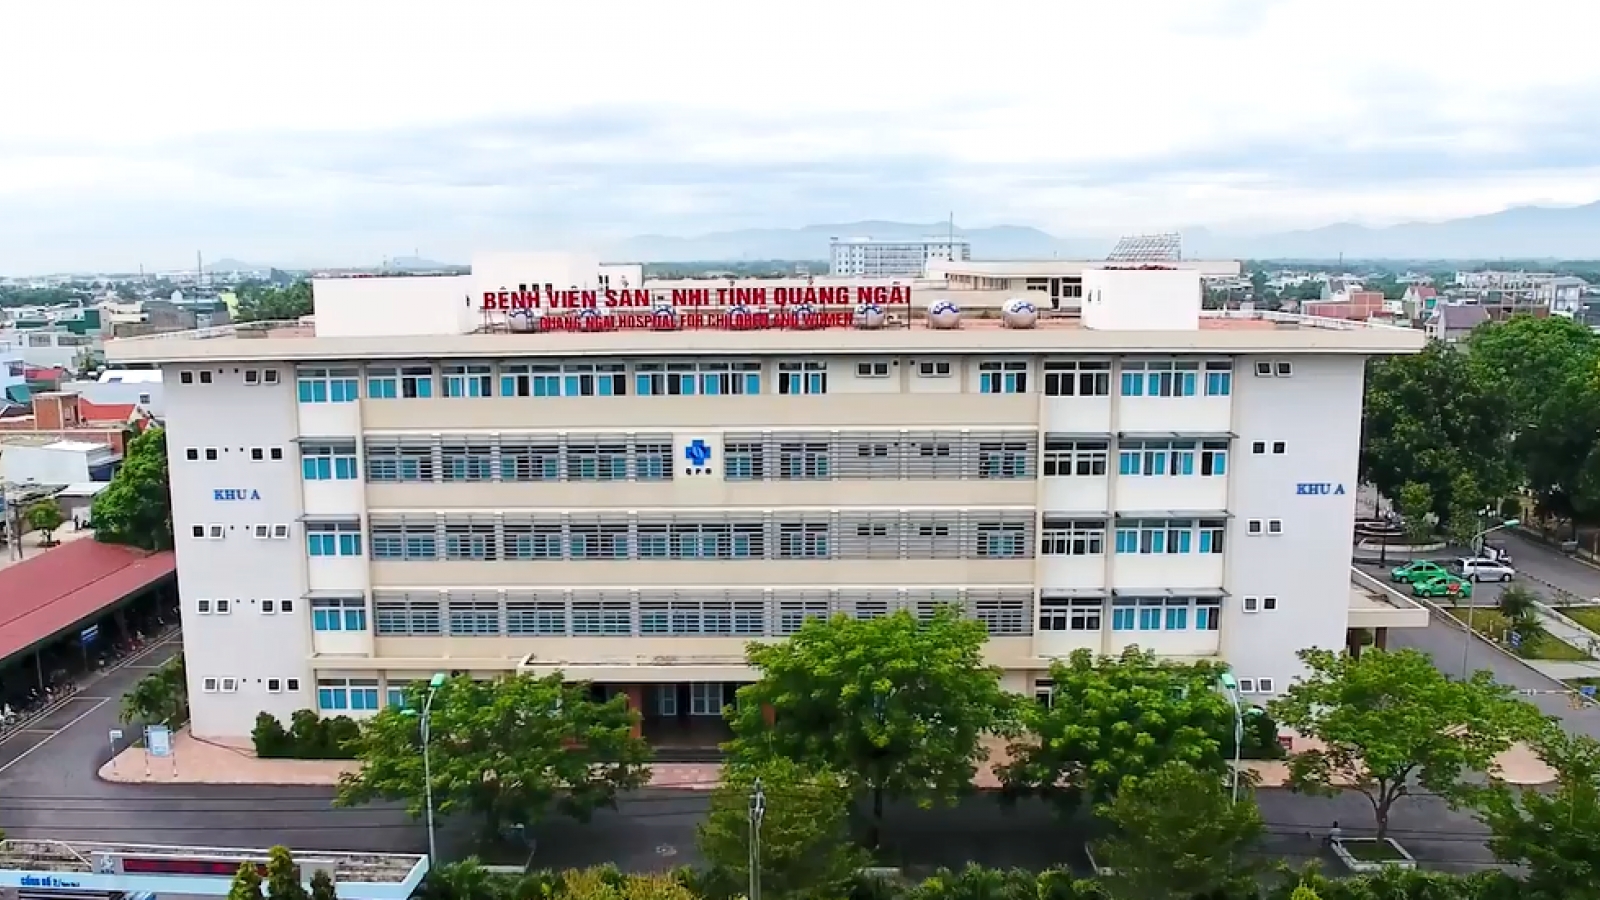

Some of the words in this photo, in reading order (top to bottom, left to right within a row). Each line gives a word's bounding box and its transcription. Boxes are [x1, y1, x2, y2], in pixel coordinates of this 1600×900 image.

[672, 289, 710, 307] NHI
[717, 280, 767, 305] TỈNH
[773, 277, 849, 307] QUẢNG
[857, 281, 911, 305] NGÃI
[680, 314, 703, 327] FOR
[803, 312, 854, 327] WOMEN
[214, 488, 247, 501] KHU
[250, 488, 261, 501] A
[1296, 483, 1331, 495] KHU
[1333, 483, 1346, 495] A
